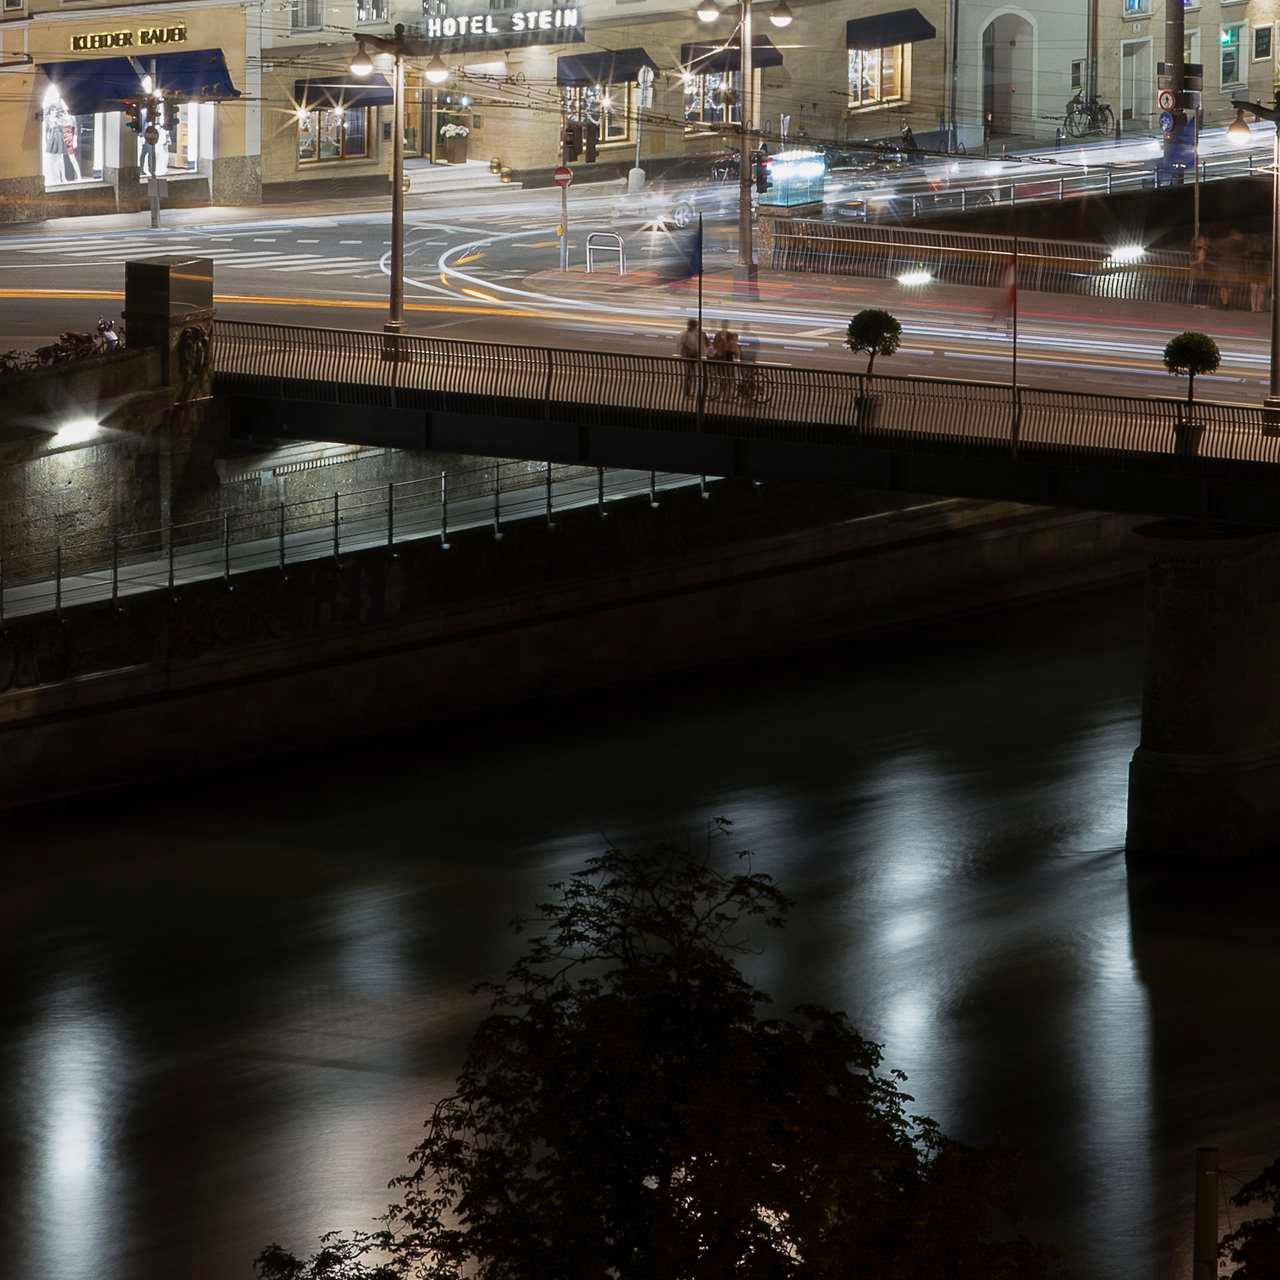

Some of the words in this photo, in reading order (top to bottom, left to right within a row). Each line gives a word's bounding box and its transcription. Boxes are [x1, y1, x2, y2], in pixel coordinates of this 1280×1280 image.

[428, 14, 499, 38] HOTEL
[511, 8, 578, 31] STEIN
[72, 31, 133, 51] KLEIDER
[139, 26, 188, 45] BAUER
